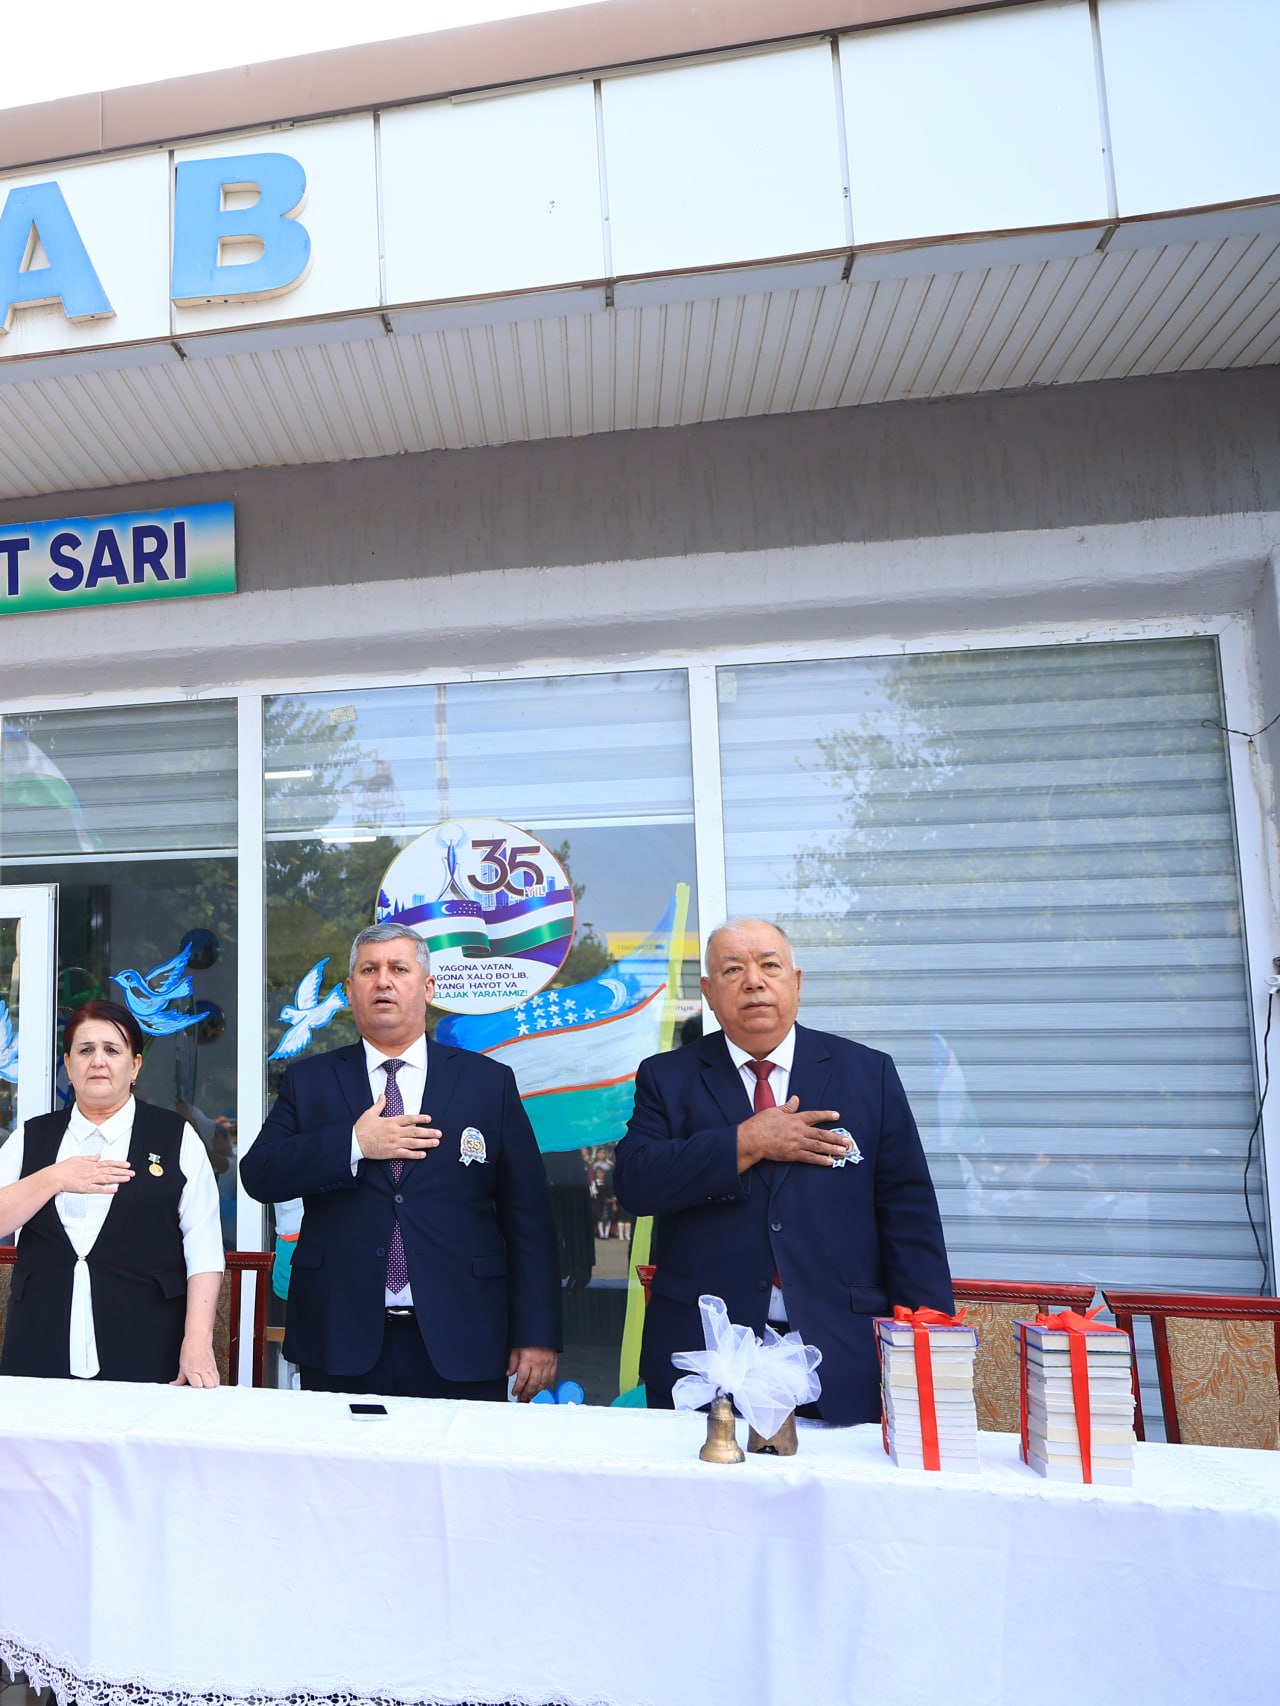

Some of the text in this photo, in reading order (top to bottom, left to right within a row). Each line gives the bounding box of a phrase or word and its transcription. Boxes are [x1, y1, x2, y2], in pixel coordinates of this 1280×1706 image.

[47, 520, 188, 593] SARI
[467, 838, 544, 897] 35
[526, 886, 546, 897] YIL
[438, 963, 514, 972] YAGONA VATAN,
[432, 973, 464, 981] AGONA
[466, 973, 493, 981] XALQ
[436, 982, 465, 990] YANGI
[469, 981, 502, 989] HAYOT
[433, 989, 528, 999] ELAJAK YARATAMIZ!
[467, 1138, 482, 1150] 35
